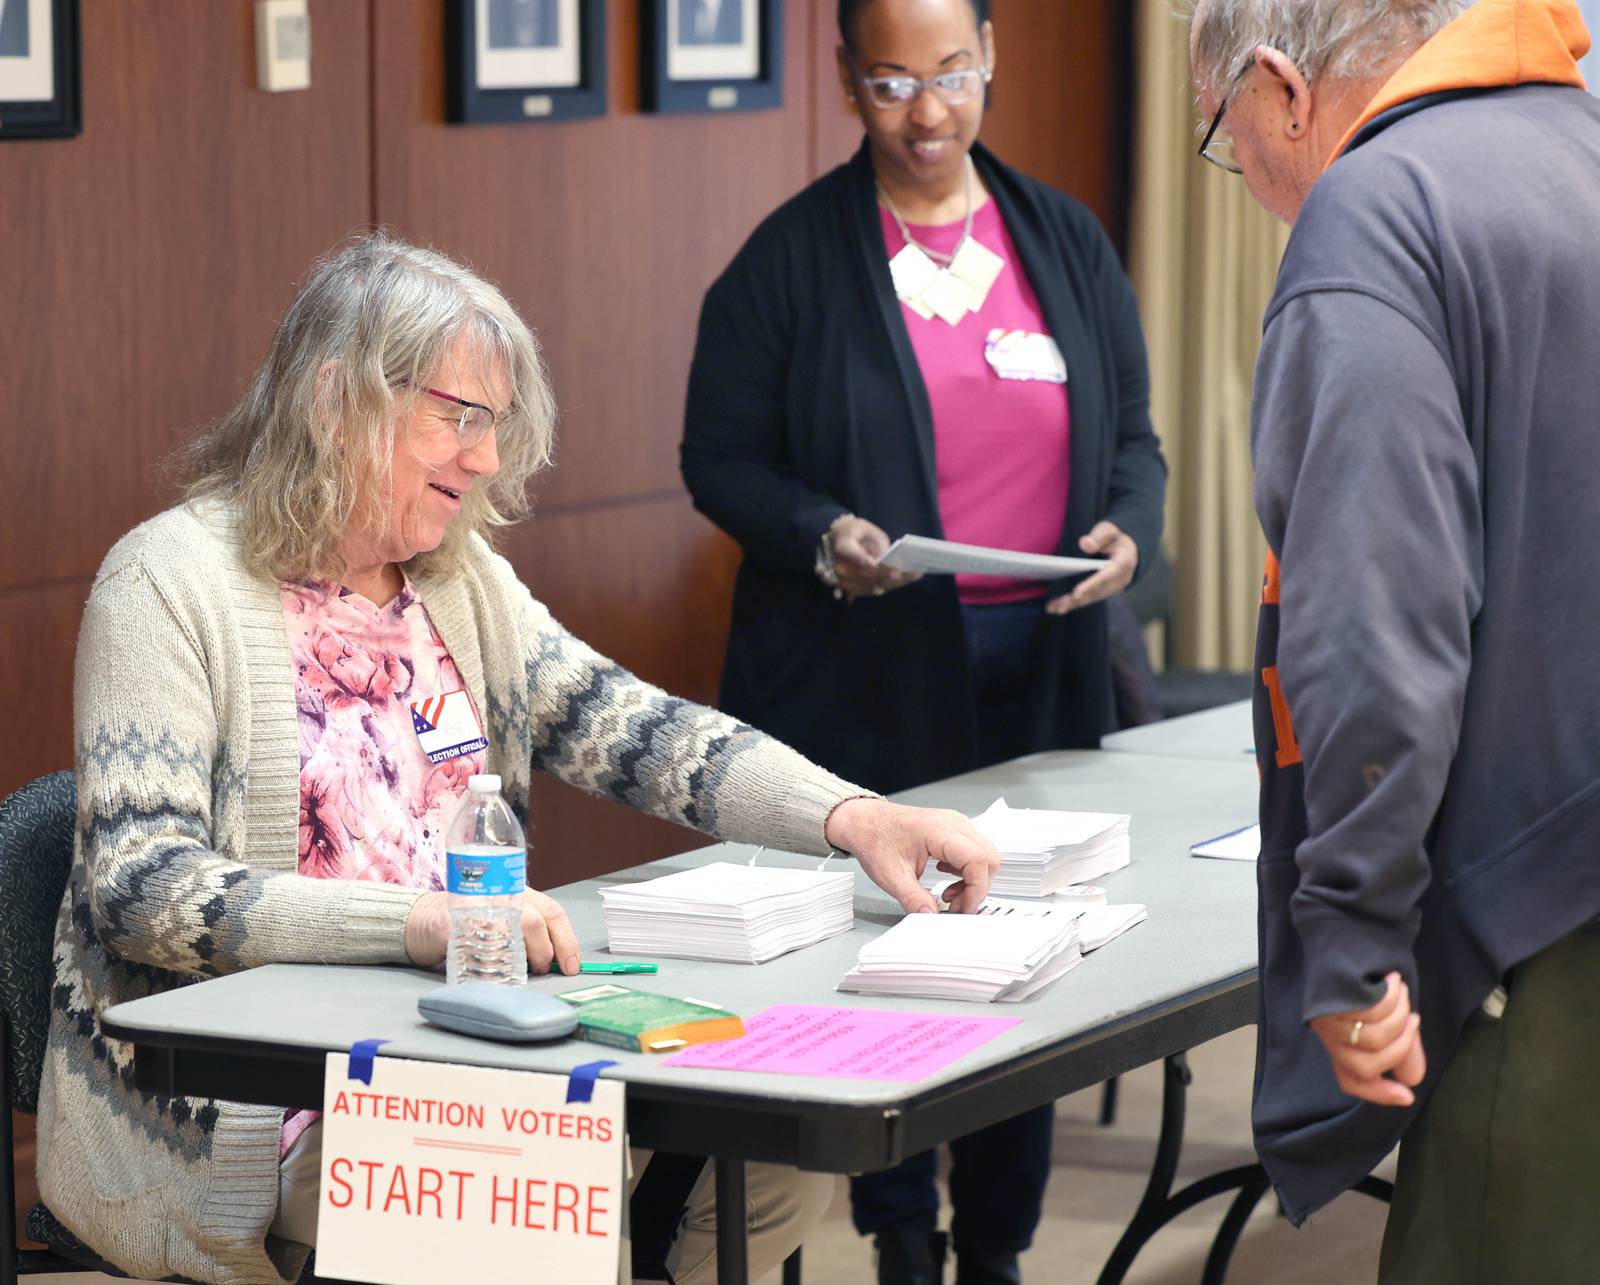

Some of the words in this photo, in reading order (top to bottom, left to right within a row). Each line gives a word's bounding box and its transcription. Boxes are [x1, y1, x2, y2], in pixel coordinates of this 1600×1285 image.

[429, 747, 461, 763] LECTION
[460, 740, 486, 754] OFFICIAL
[332, 1091, 484, 1129] ATTENTION
[501, 1107, 613, 1143] VOTERS
[328, 1157, 475, 1221] START
[490, 1174, 610, 1238] HERE
